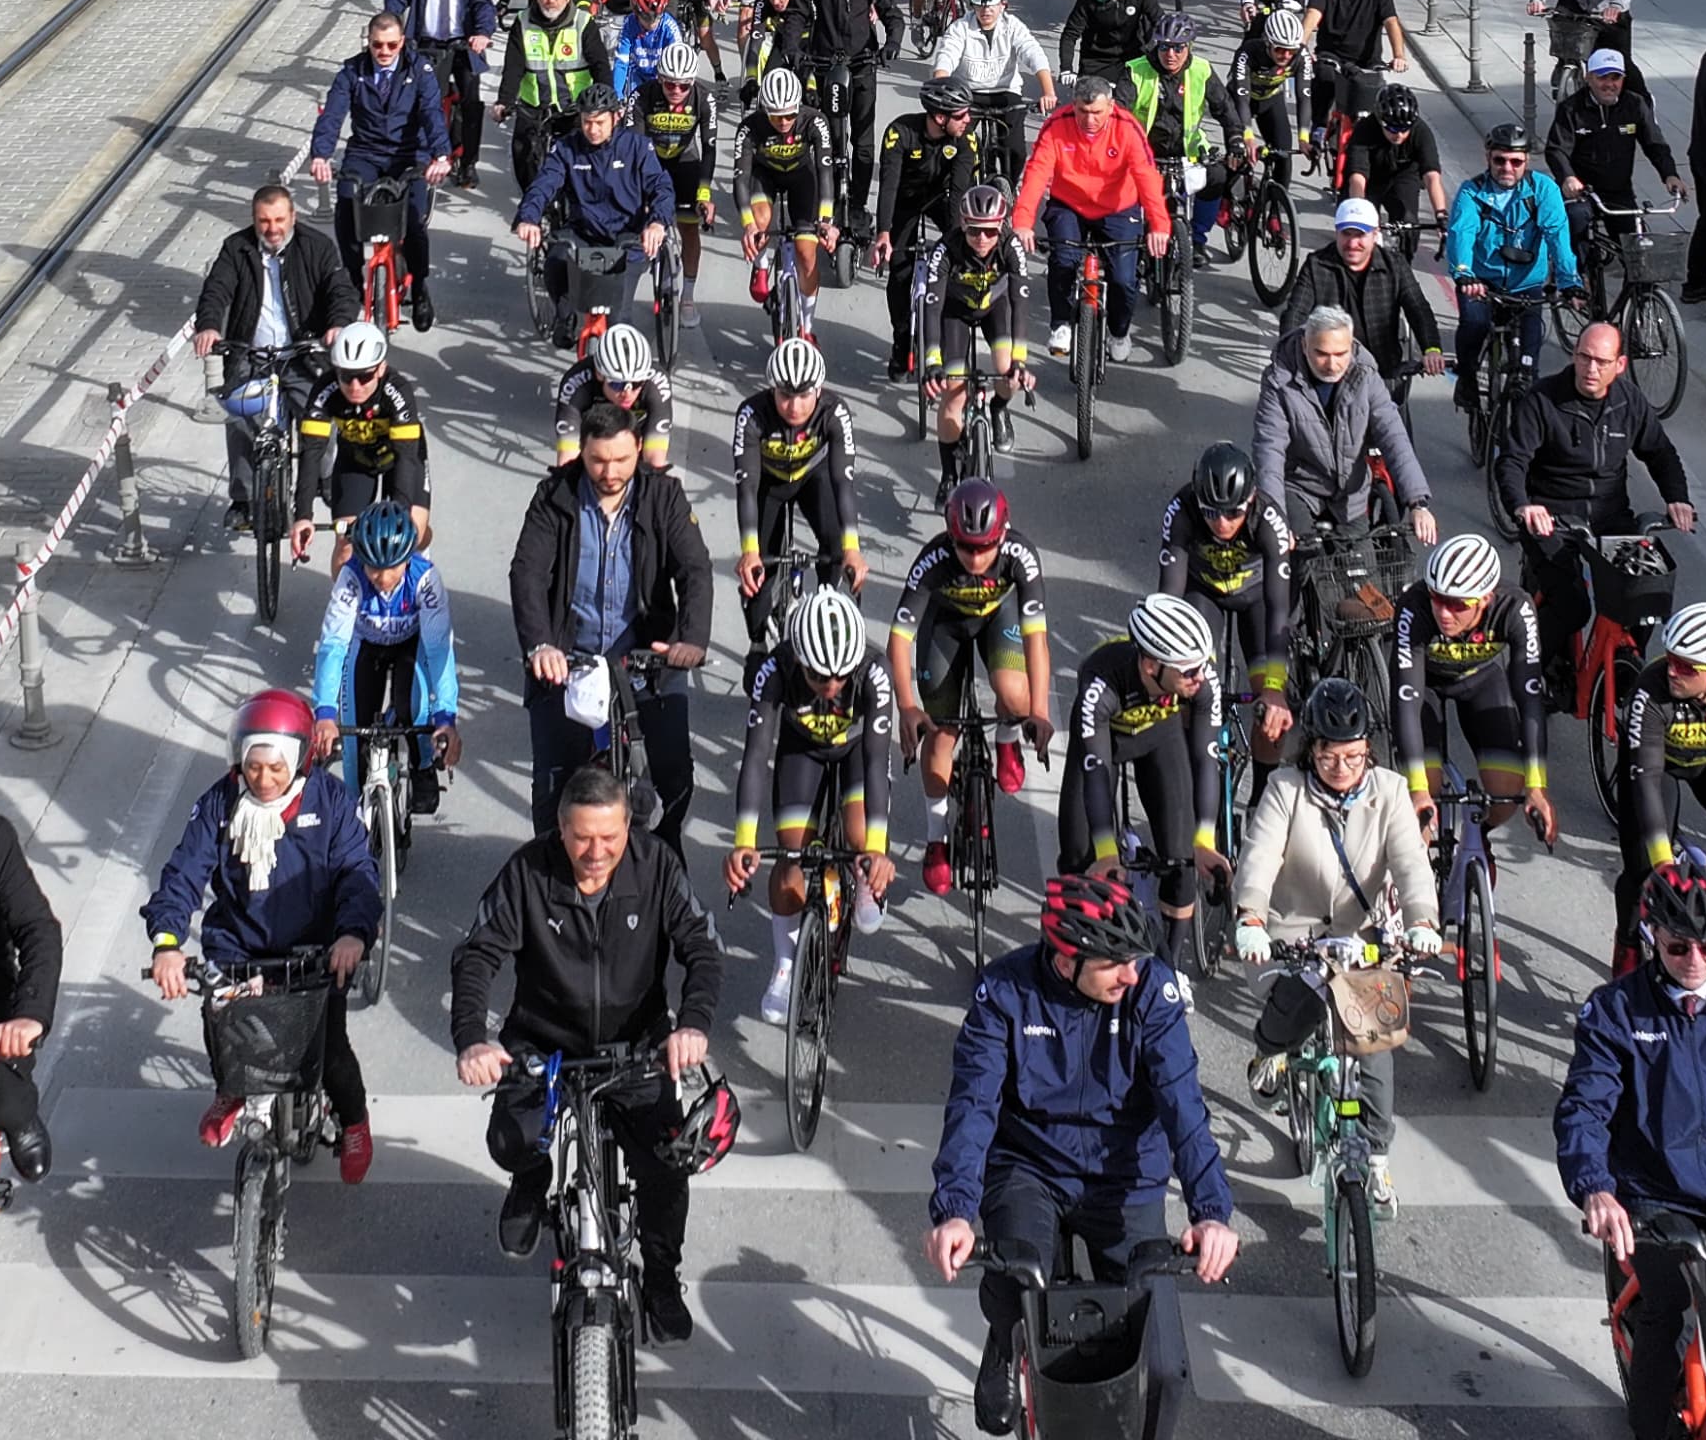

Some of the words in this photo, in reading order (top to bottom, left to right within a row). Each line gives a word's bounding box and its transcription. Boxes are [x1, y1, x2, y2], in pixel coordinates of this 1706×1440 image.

[652, 114, 690, 125] KONYA
[645, 368, 671, 402] ONYA
[734, 404, 754, 456] KONYA
[835, 403, 856, 455] KONYA
[1162, 497, 1181, 542] KON
[1263, 506, 1290, 556] ONYA
[907, 546, 950, 591] KONYA
[1001, 541, 1039, 582] KONYA
[1397, 608, 1414, 669] KONYA
[1519, 601, 1540, 664] KONYA
[752, 656, 777, 702] KON
[868, 662, 891, 709] NYA
[1204, 663, 1223, 727] KONYA
[1081, 676, 1106, 739] KONYA
[1628, 688, 1650, 750] KONYA
